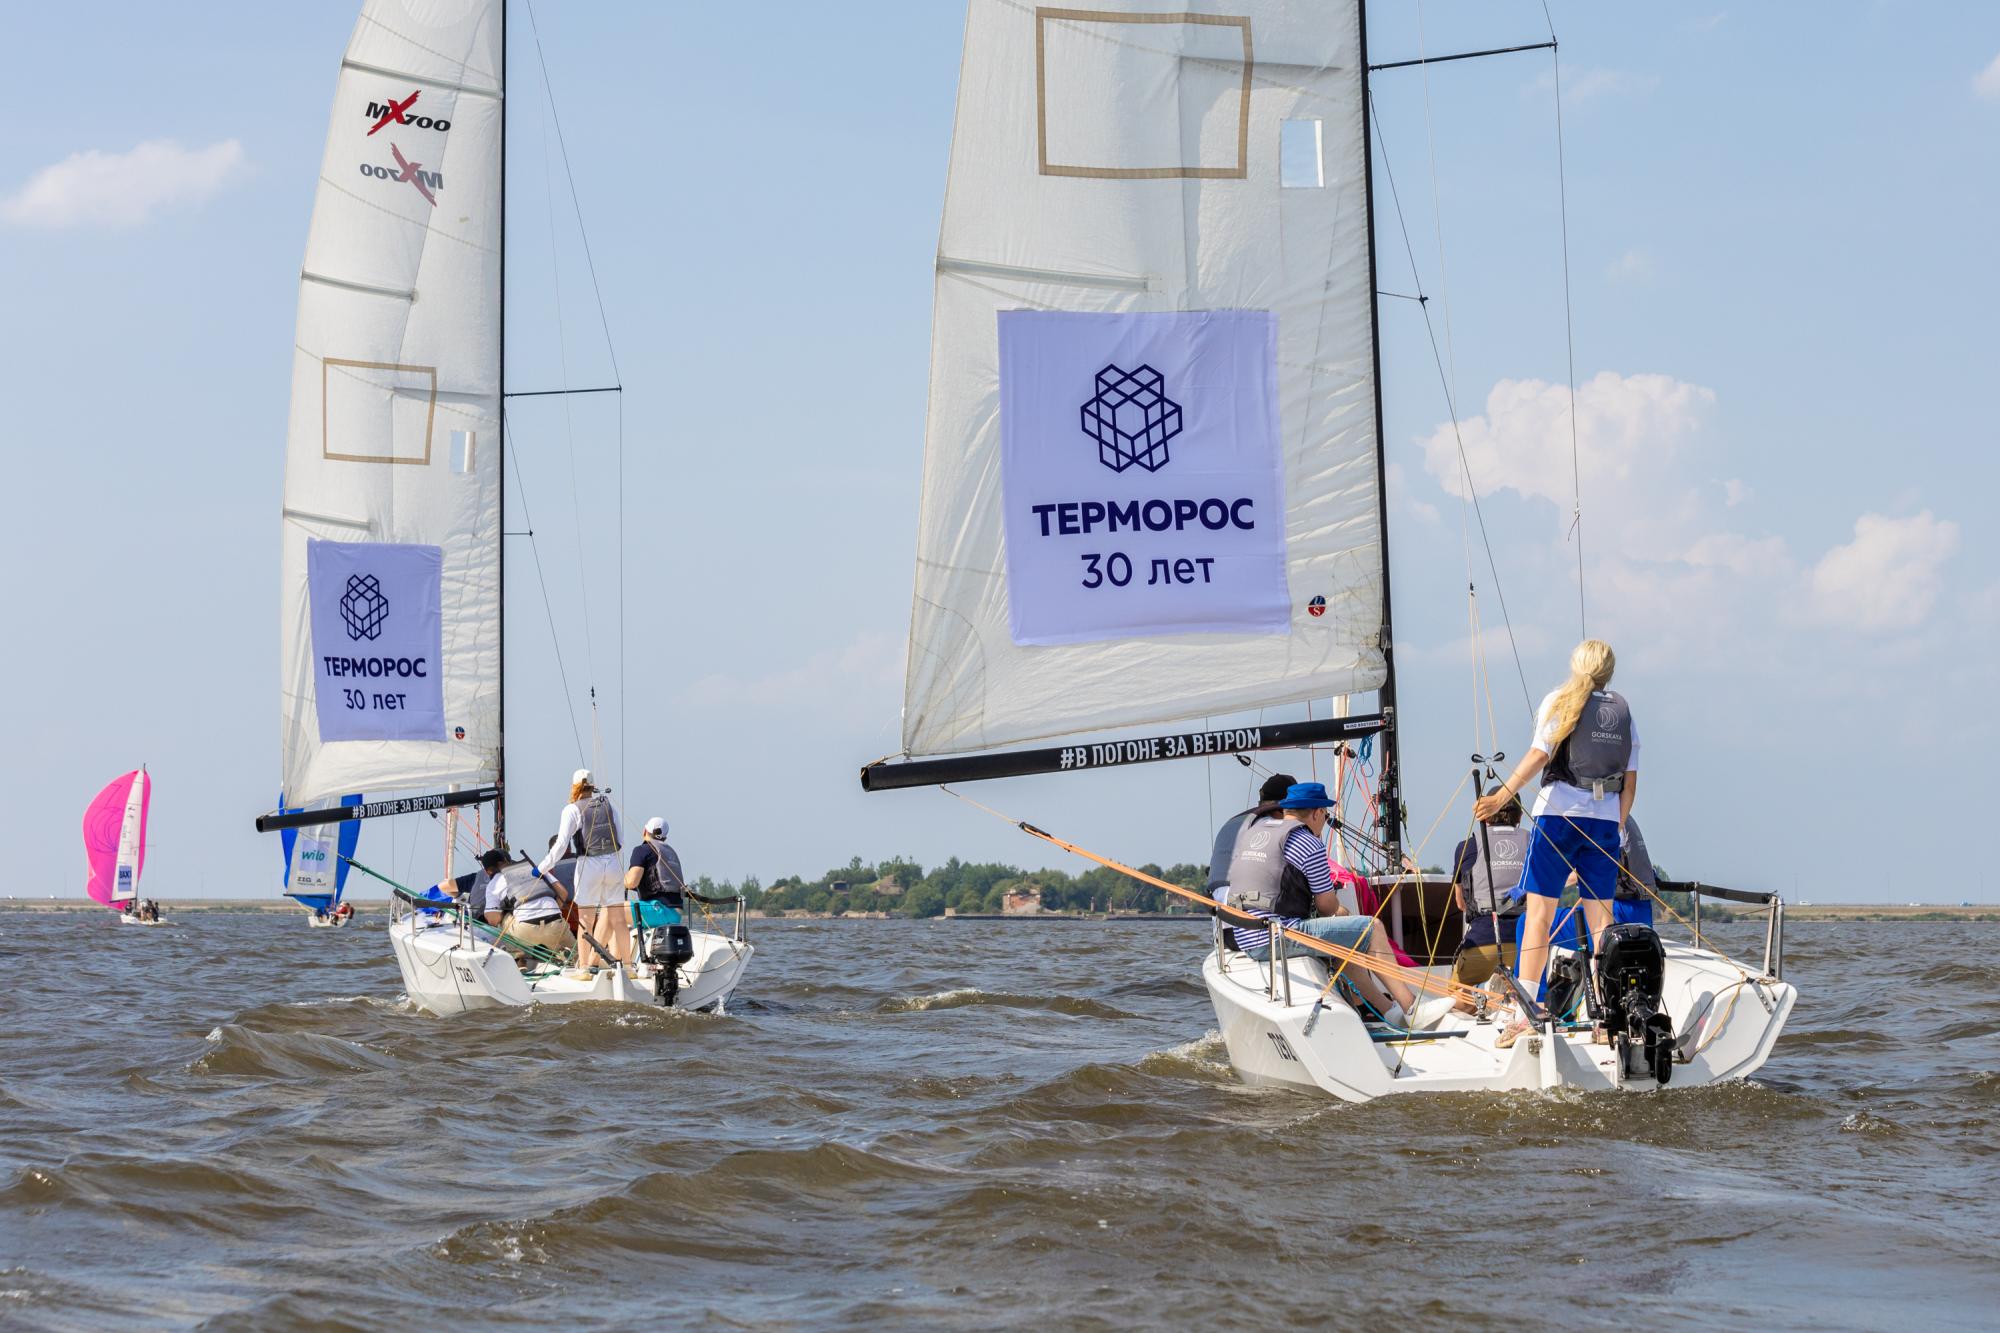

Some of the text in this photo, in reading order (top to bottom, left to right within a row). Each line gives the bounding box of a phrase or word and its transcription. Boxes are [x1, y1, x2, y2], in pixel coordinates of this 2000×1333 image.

[1032, 497, 1255, 537] ТЕРМОРОС
[1081, 551, 1215, 589] 30 лет
[323, 656, 427, 678] ТЕРМОРОС
[343, 688, 407, 711] 30 лет
[1060, 728, 1261, 769] #В ПОГОНЕ ЗА ВЕТРОМ
[352, 795, 446, 818] #В ПОГОНЕ ЗА ВЕТРОМ
[302, 849, 325, 861] wilo
